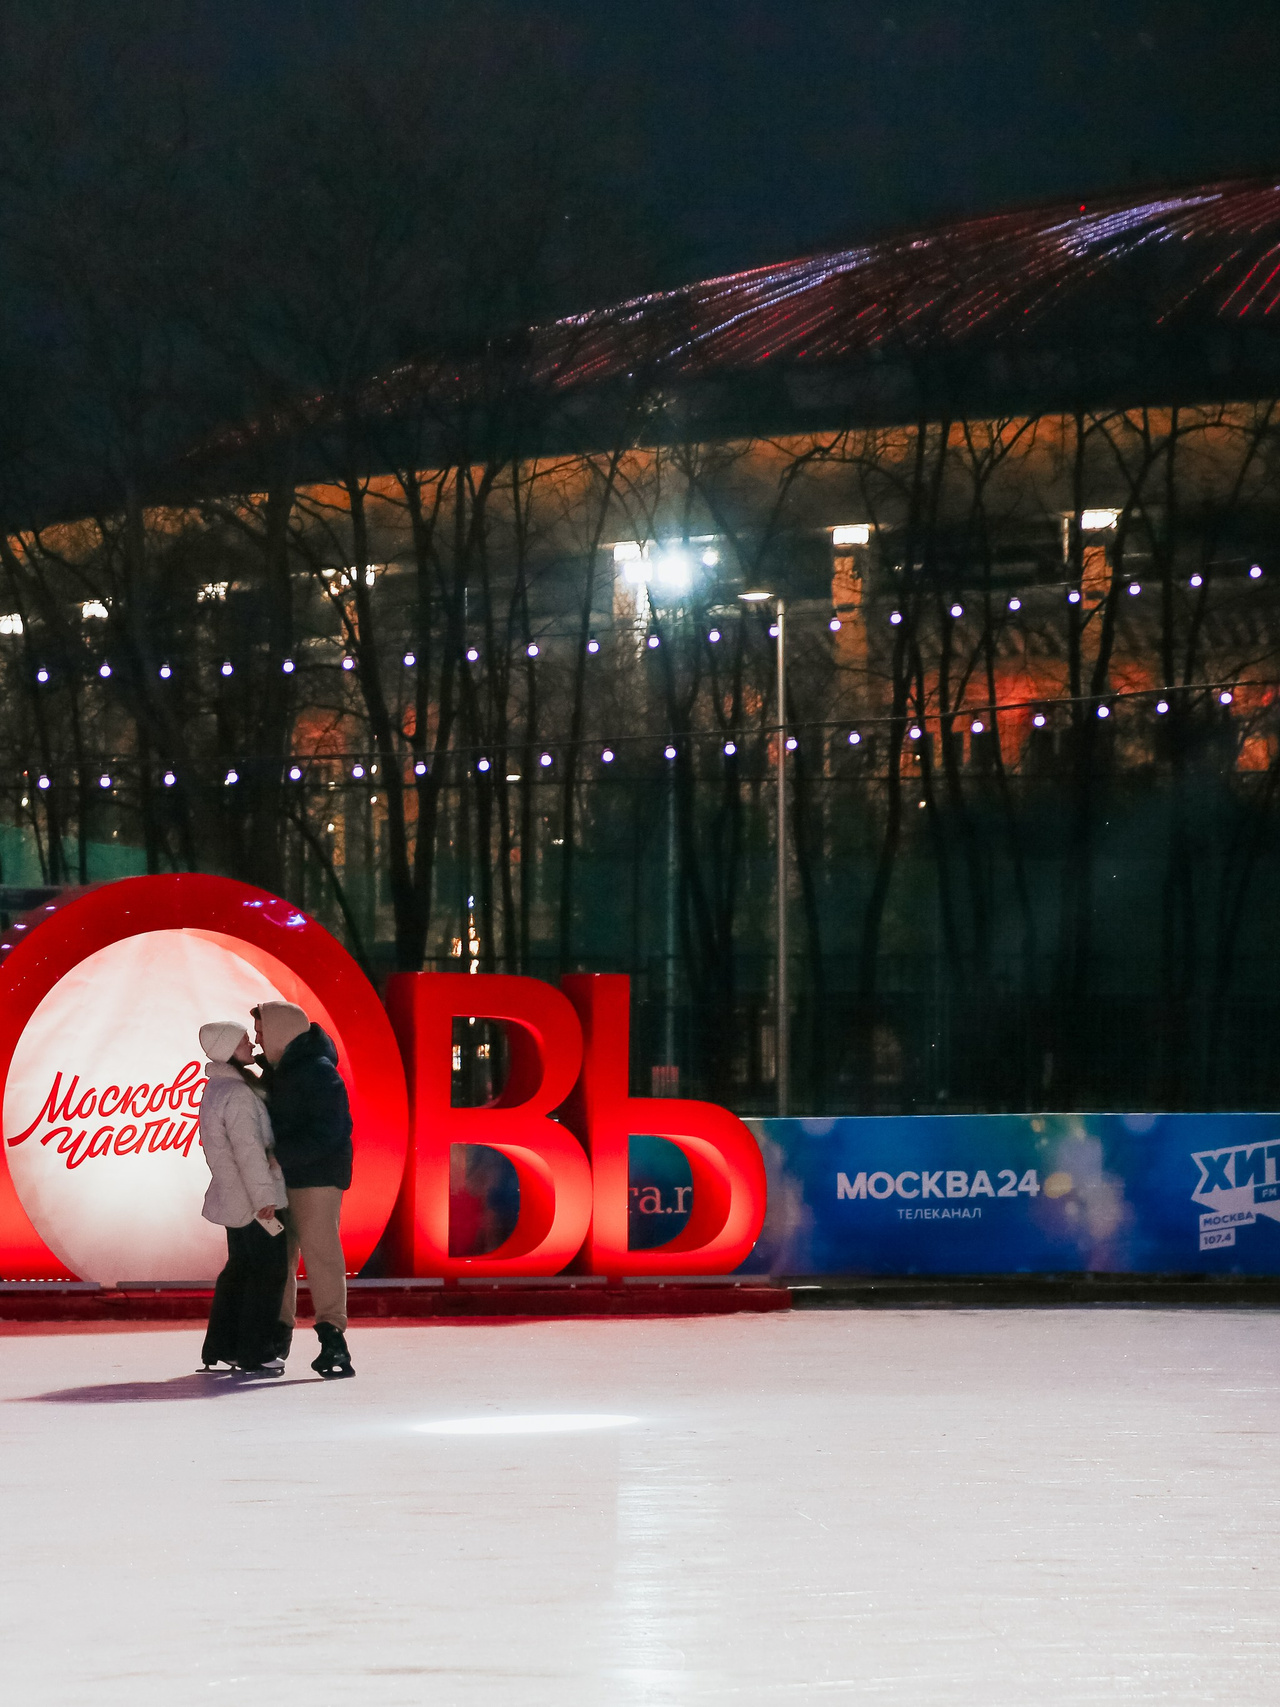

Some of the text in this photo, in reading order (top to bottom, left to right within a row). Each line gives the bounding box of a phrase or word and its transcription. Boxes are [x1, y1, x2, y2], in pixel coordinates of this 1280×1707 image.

[1262, 1187, 1277, 1199] FM
[897, 1207, 982, 1220] ТЕЛЕКАНАЛ
[1203, 1211, 1254, 1227] МОСКВА
[1204, 1233, 1232, 1246] 107.4
